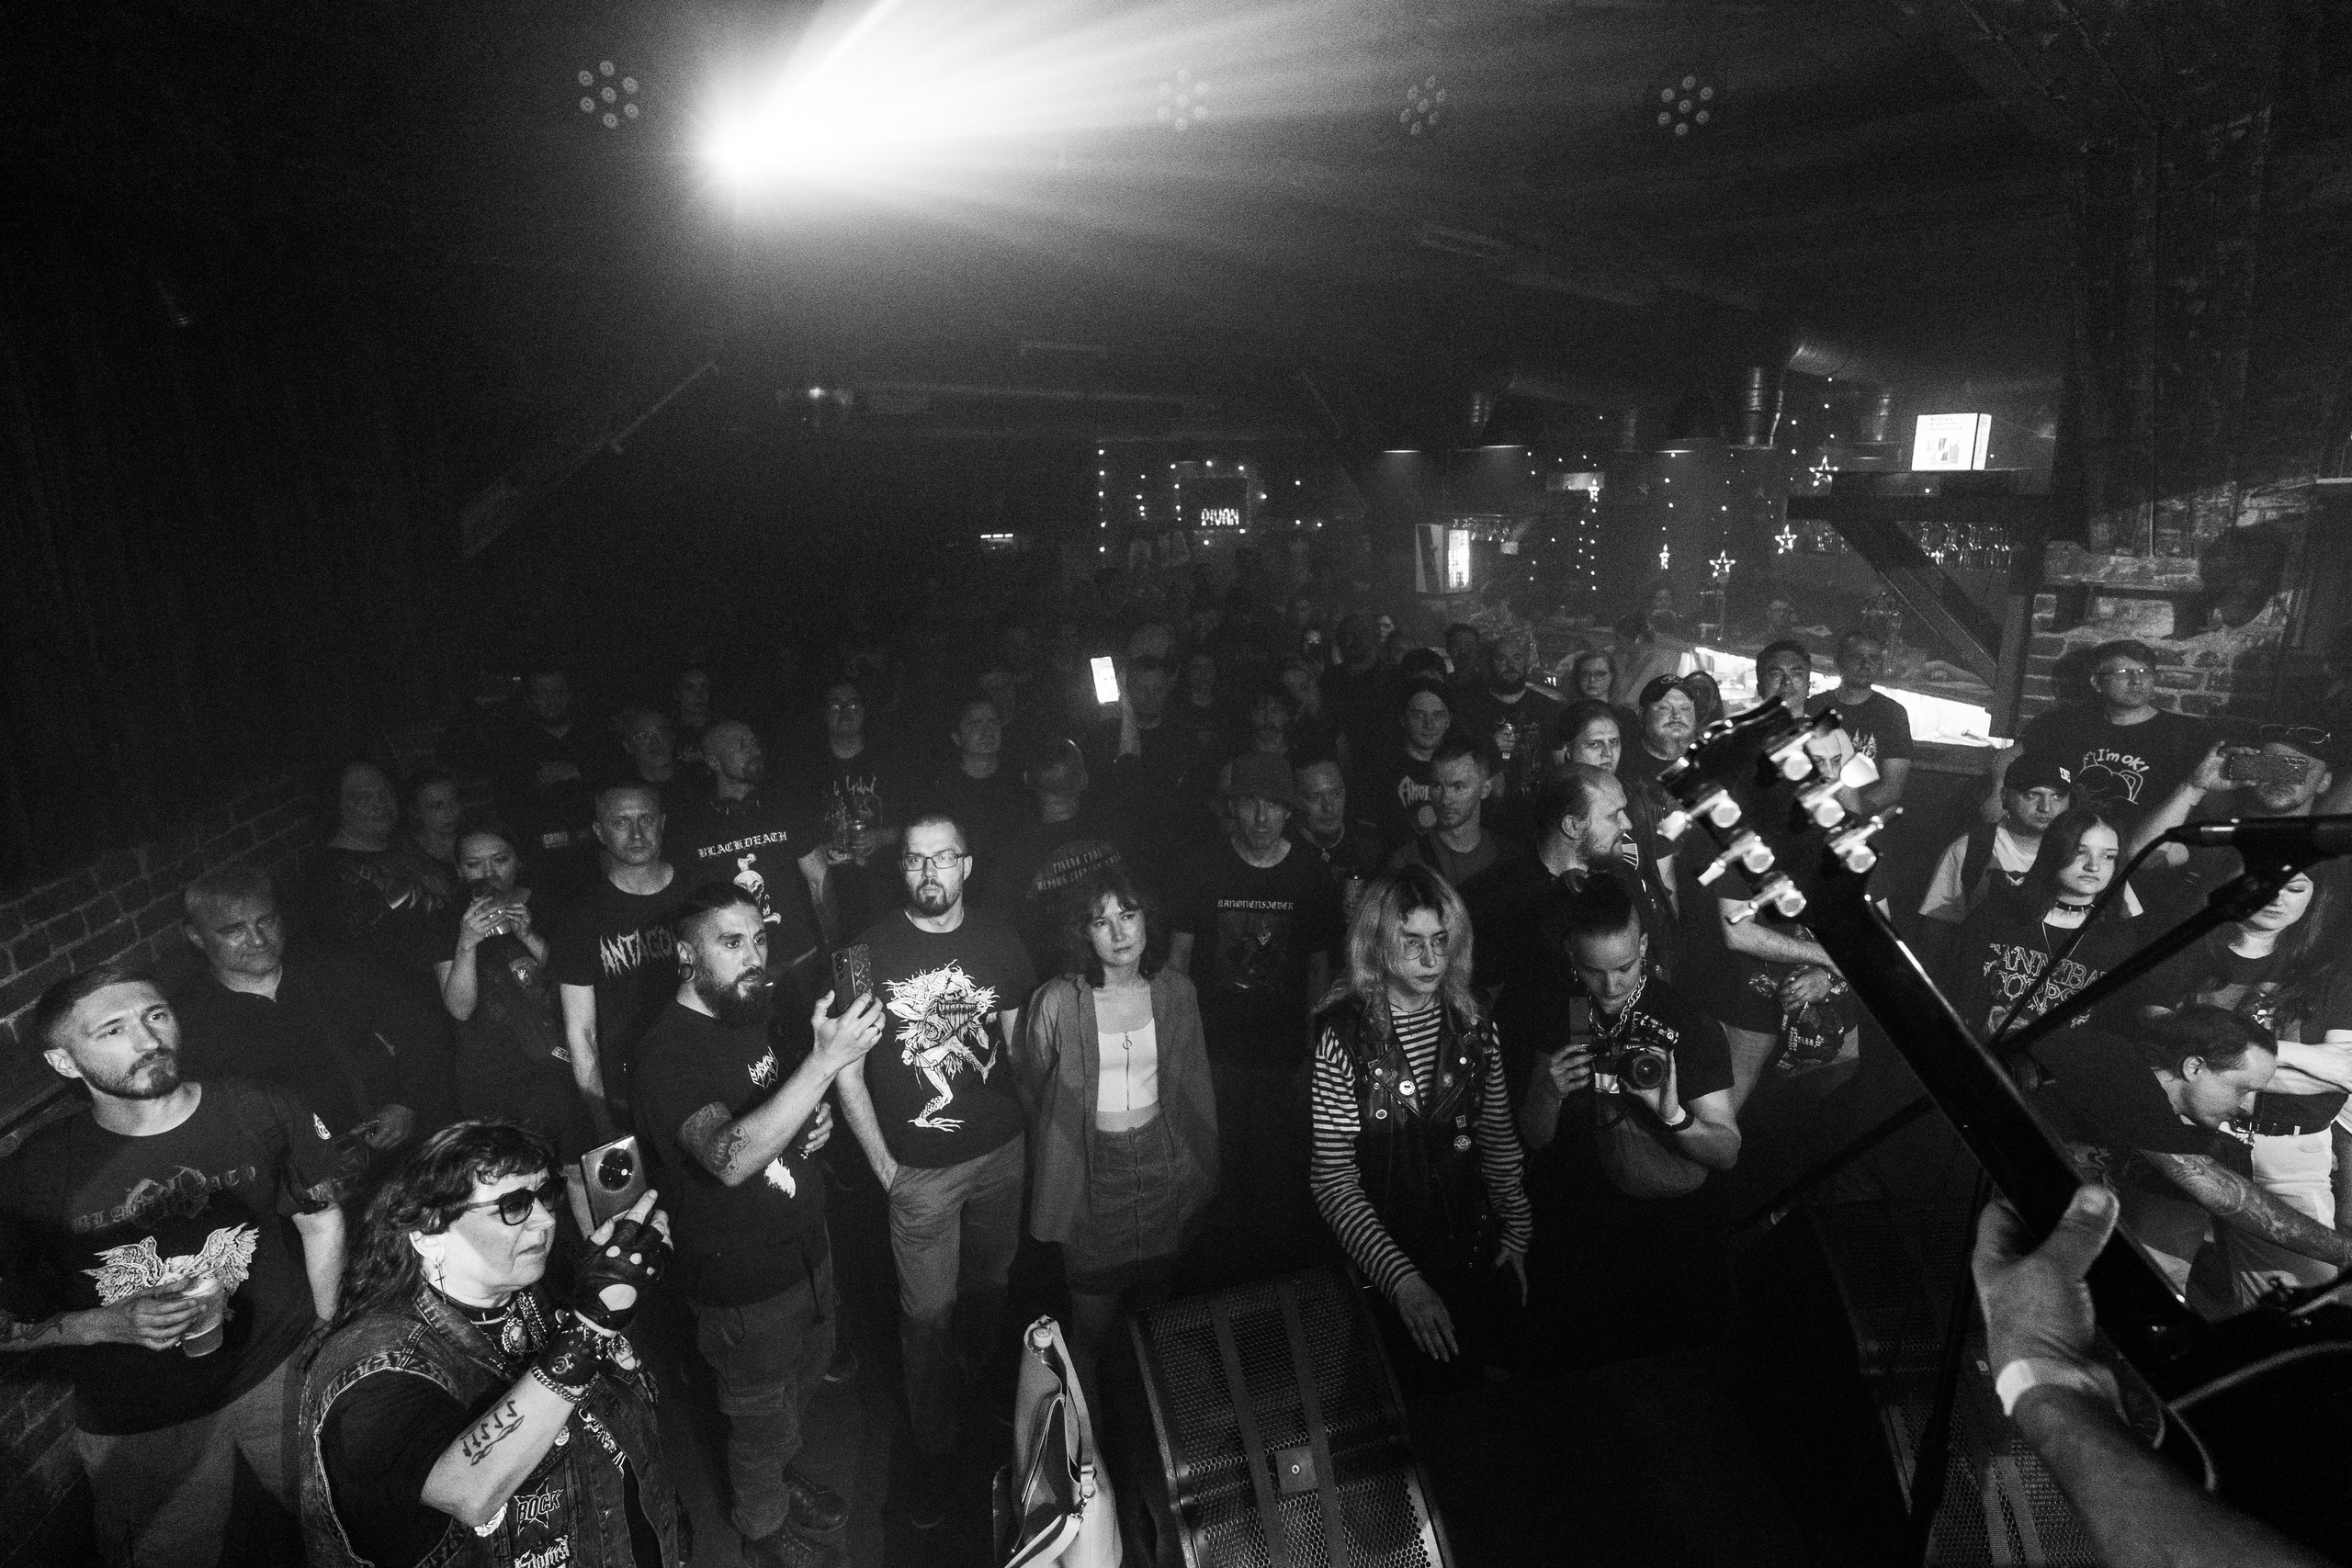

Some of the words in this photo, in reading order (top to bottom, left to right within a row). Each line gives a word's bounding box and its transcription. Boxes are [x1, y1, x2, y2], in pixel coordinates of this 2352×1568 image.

[2097, 748, 2120, 762] I'm
[696, 830, 788, 859] BLACKDEATH
[516, 1489, 562, 1523] ROCK
